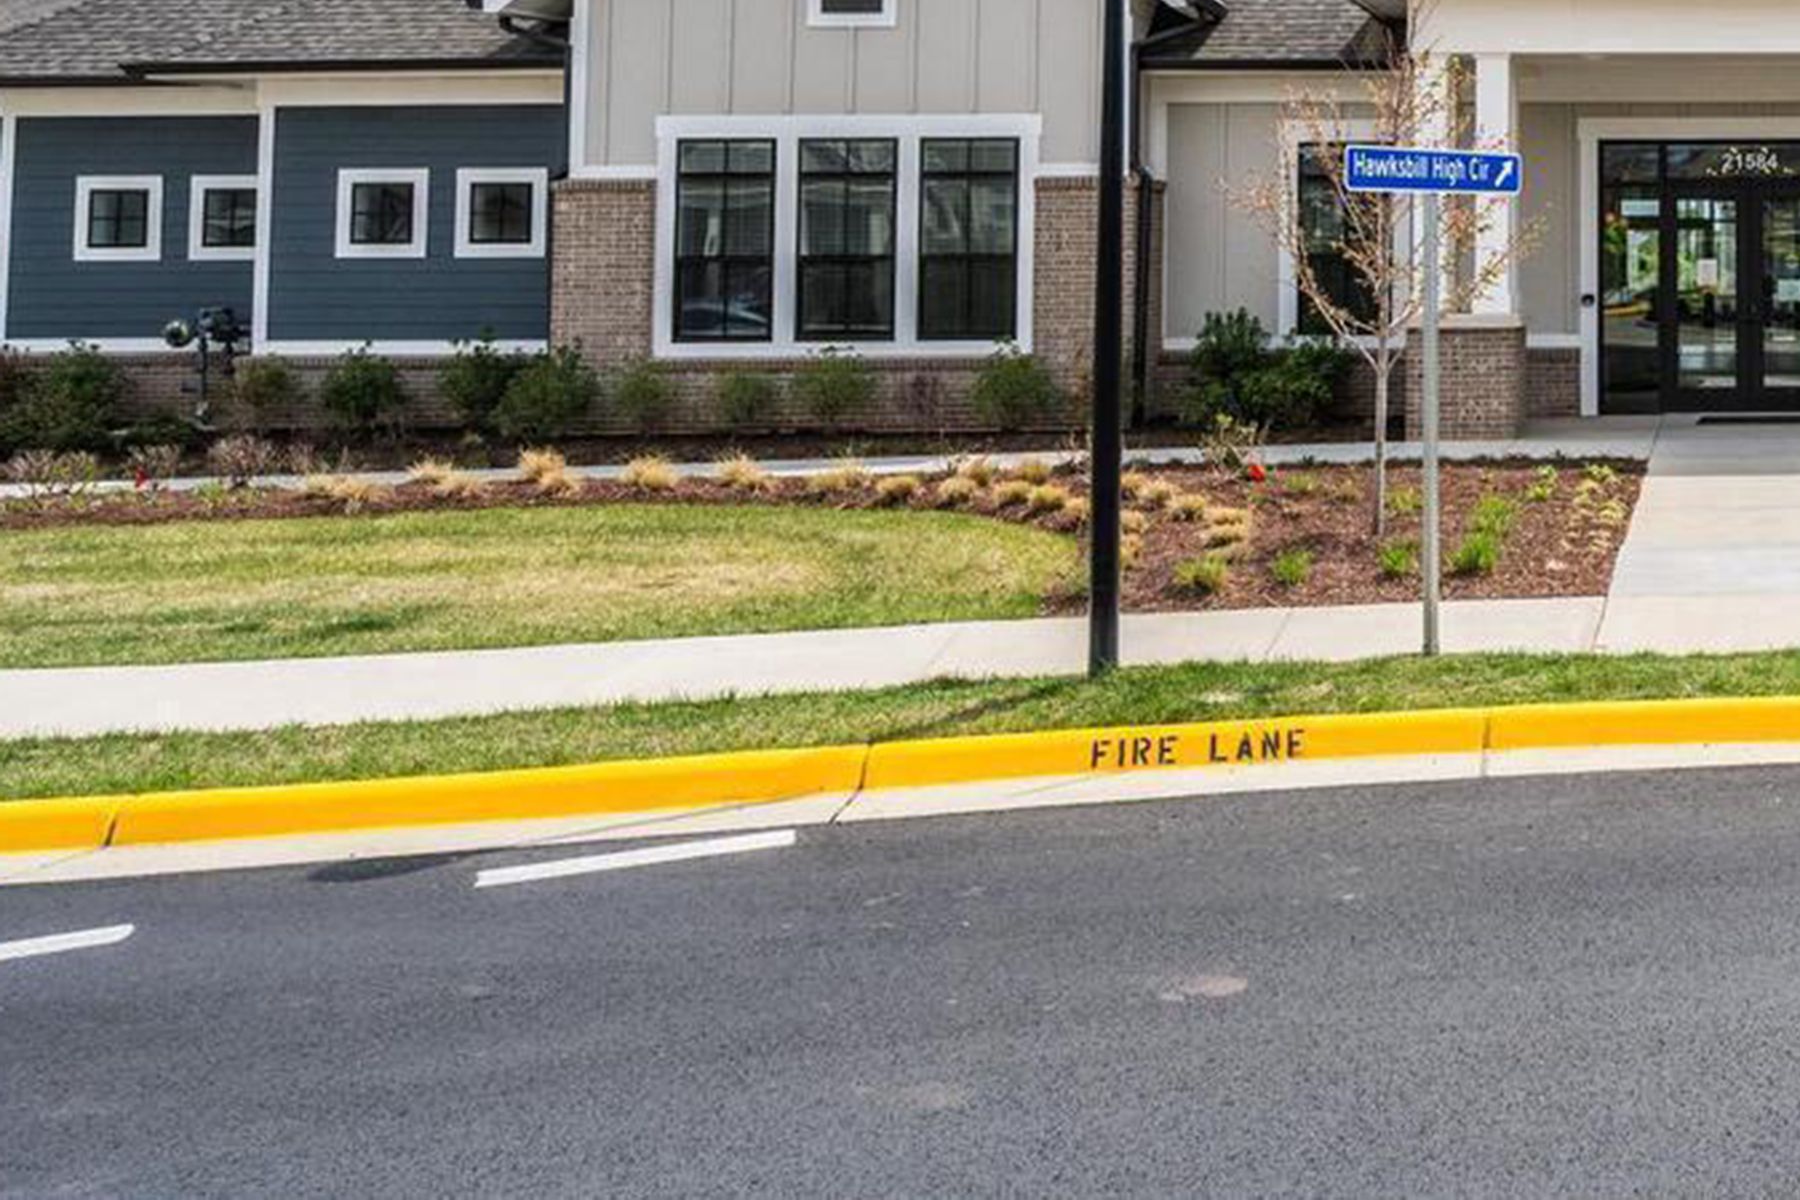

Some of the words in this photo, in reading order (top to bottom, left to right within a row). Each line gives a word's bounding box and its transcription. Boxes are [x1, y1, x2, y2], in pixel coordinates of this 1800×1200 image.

[1352, 151, 1428, 179] Hawksbill
[1432, 156, 1465, 186] High
[1469, 157, 1490, 181] Cir
[1090, 735, 1179, 769] FIRE
[1209, 729, 1305, 763] LANE
